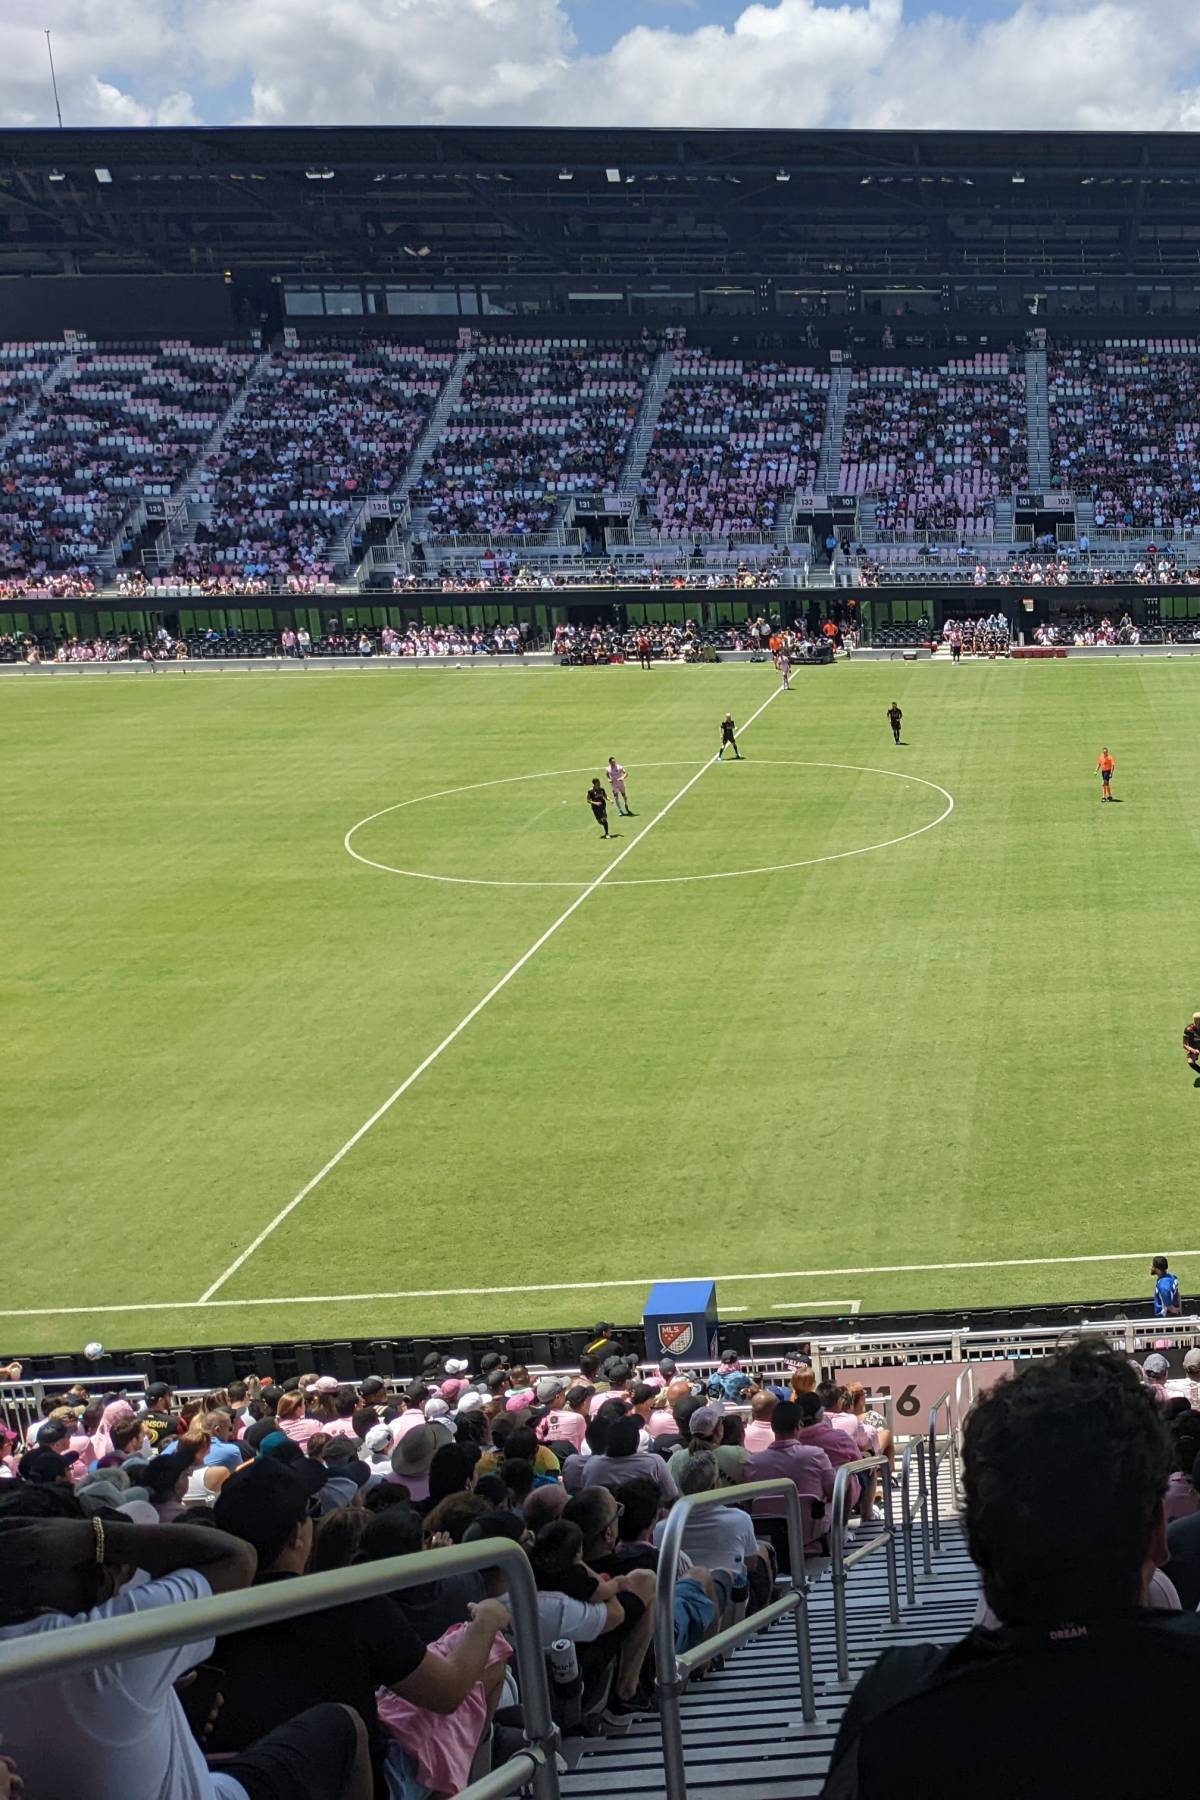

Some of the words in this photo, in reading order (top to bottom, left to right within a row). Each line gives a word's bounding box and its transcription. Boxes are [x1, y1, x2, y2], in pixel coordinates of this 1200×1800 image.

[579, 501, 590, 509] 131
[842, 498, 853, 506] 101
[1058, 497, 1070, 505] 102
[662, 1325, 679, 1333] MLS
[1049, 1625, 1088, 1640] DREAM
